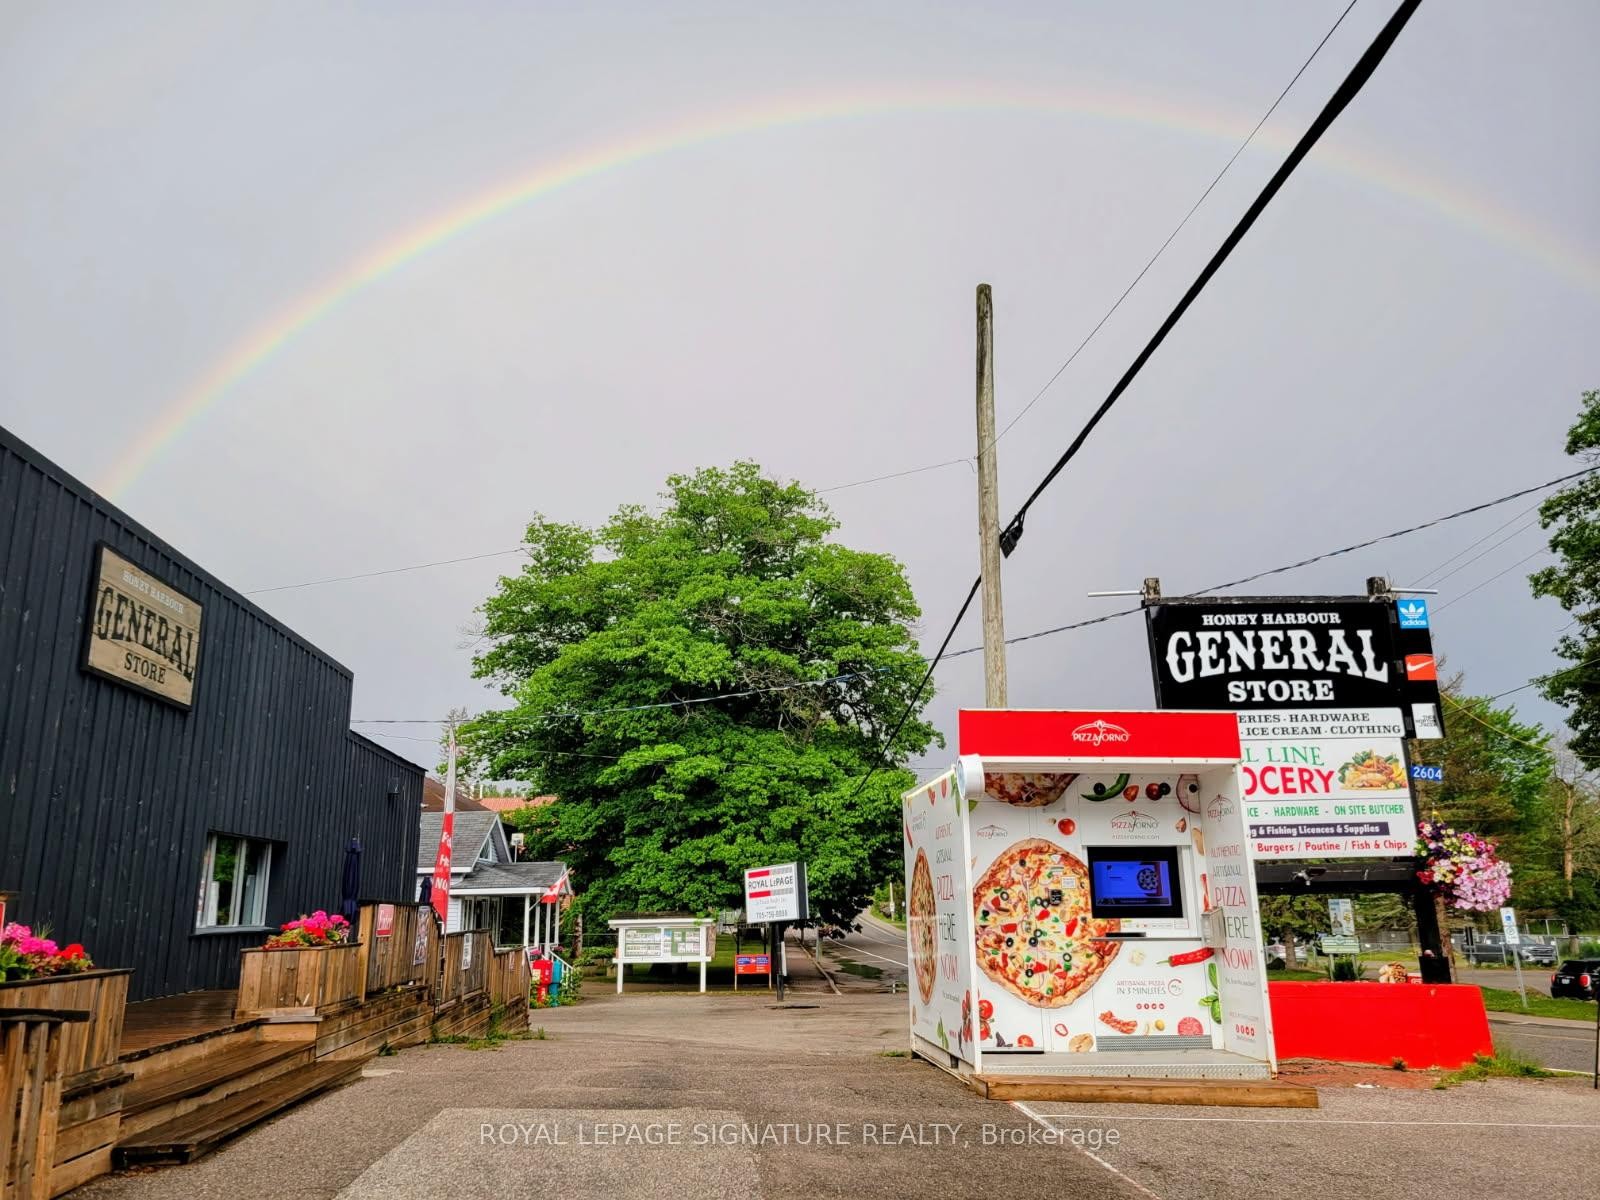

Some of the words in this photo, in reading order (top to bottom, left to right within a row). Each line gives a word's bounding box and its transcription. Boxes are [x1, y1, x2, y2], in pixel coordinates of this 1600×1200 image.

[1202, 613, 1259, 626] HONEY
[1261, 612, 1342, 625] HARBOUR
[1401, 618, 1427, 626] adidas
[97, 586, 195, 683] GENERAL
[1165, 629, 1389, 684] GENERAL
[124, 652, 167, 685] STORE
[1227, 679, 1335, 702] STORE
[1238, 713, 1281, 724] ERIES
[1289, 712, 1370, 723] HARDWARE
[1246, 726, 1269, 736] ICE
[1272, 725, 1322, 736] CREAM
[1330, 724, 1400, 735] CLOTHING
[1267, 746, 1325, 766] LINE
[1412, 766, 1442, 780] 2604
[1273, 806, 1320, 817] HARDWARE
[1334, 806, 1346, 816] ON
[1350, 805, 1366, 815] SITE
[1369, 804, 1405, 815] BUTCHER
[1259, 825, 1265, 835] &
[1266, 825, 1297, 837] Fishing
[1299, 825, 1335, 835] Licences
[1336, 825, 1343, 834] &
[1344, 824, 1380, 836] Supplies
[1257, 842, 1295, 854] Burgers
[1305, 841, 1341, 851] Poutine
[1351, 840, 1371, 850] Fish
[1373, 841, 1380, 850] &
[1383, 840, 1408, 851] Chips
[748, 879, 769, 890] ROYAL
[936, 874, 955, 901] PIZZA
[1214, 886, 1247, 907] PIZZA
[1222, 947, 1255, 971] NOW!
[1117, 986, 1125, 995] IN
[1132, 986, 1166, 995] MINUTES
